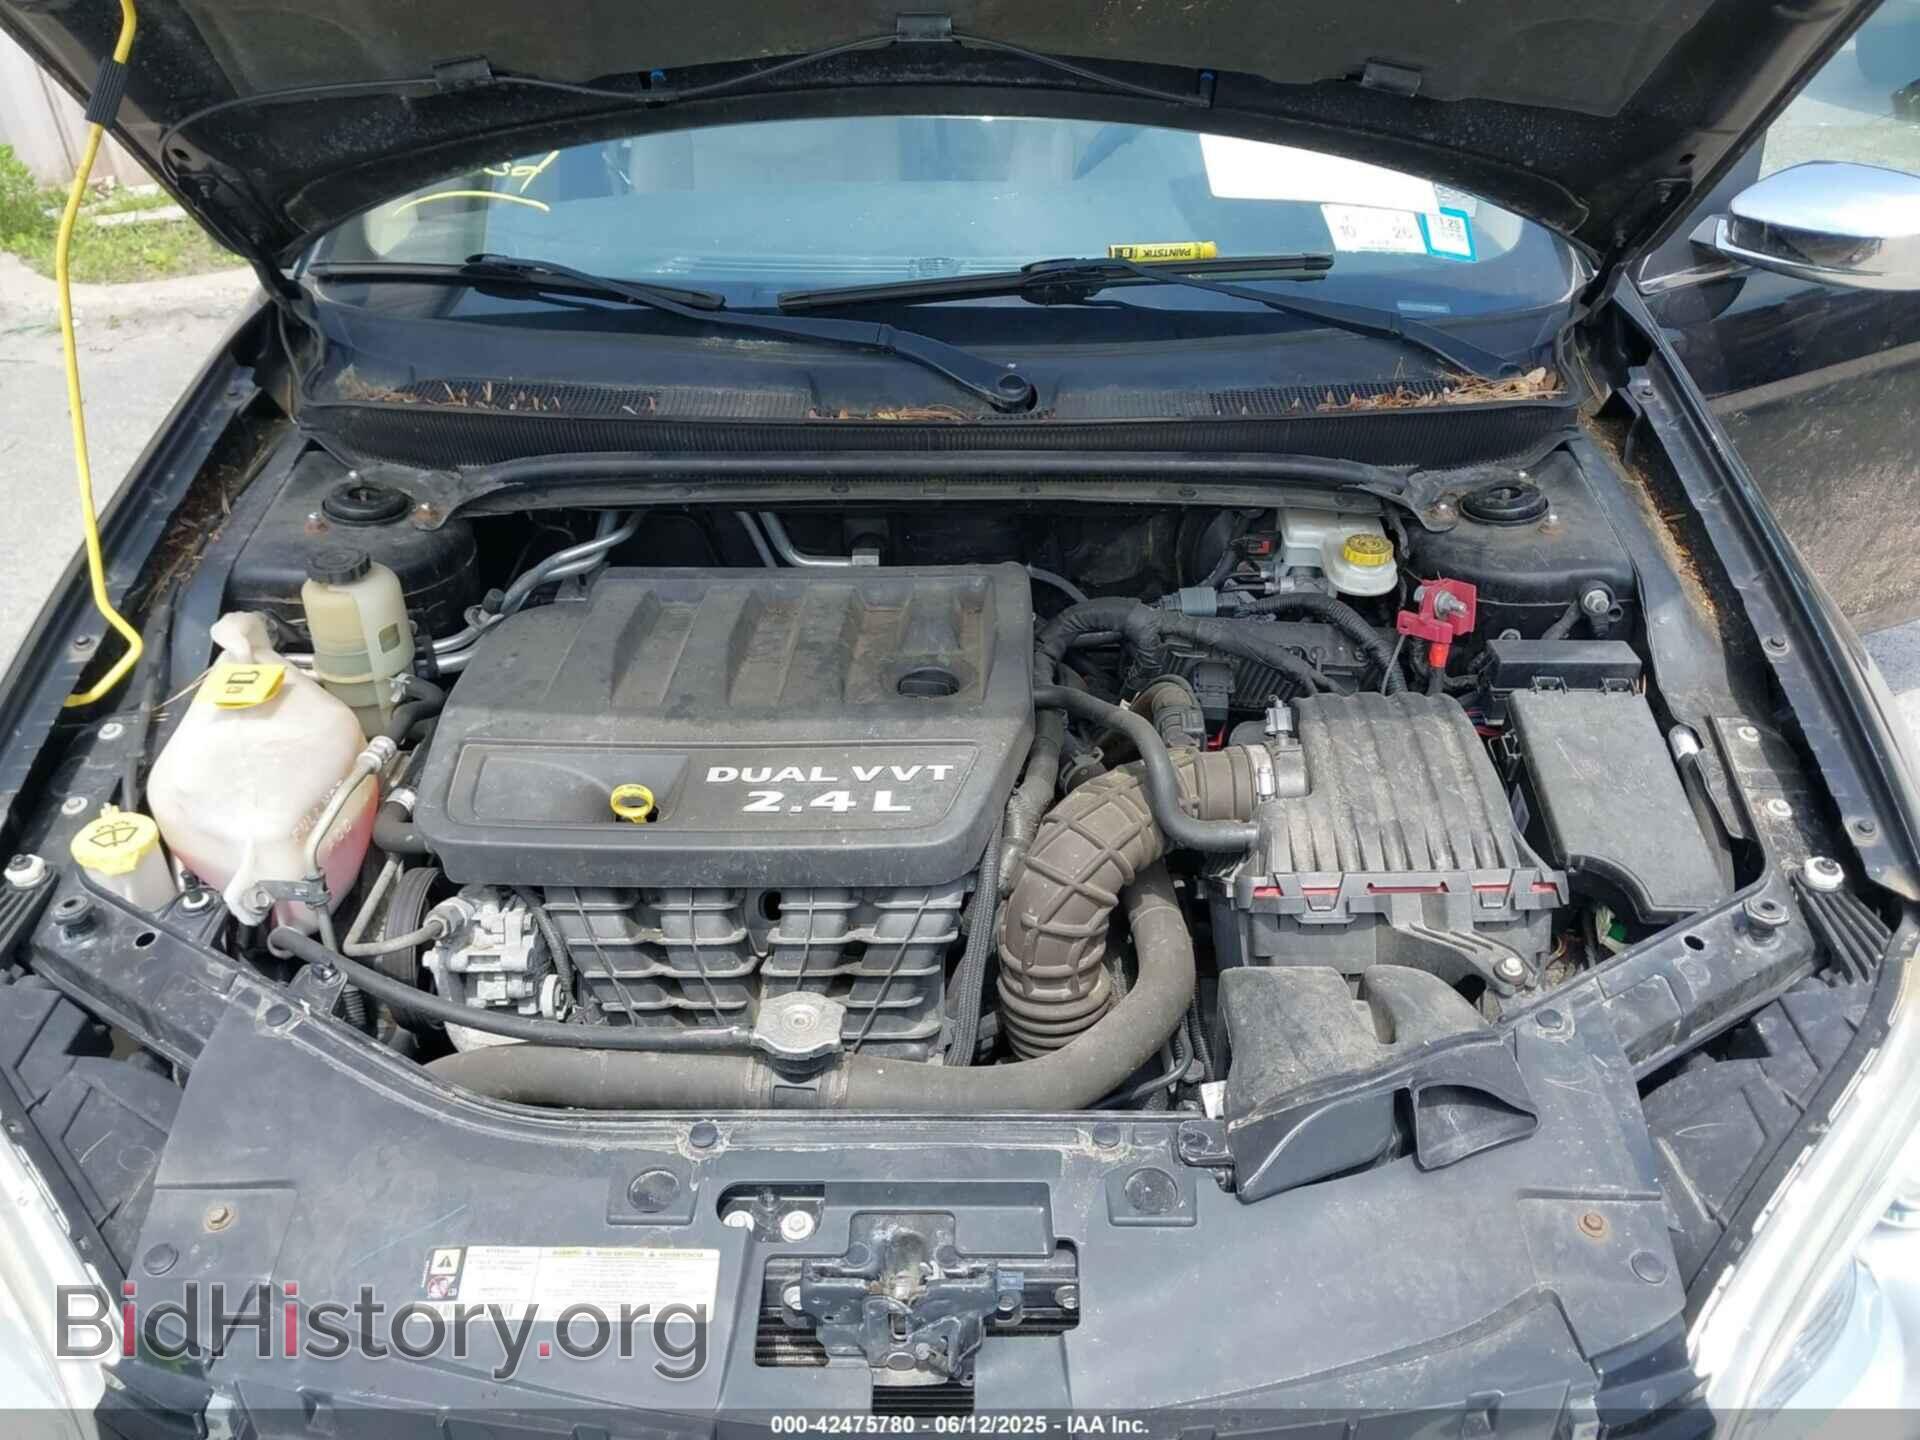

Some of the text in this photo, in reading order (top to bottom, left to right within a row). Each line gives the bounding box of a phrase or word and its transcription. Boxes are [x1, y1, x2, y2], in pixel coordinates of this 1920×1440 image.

[1143, 247, 1192, 257] PAINTSTIK
[705, 765, 954, 783] DUAL VVT
